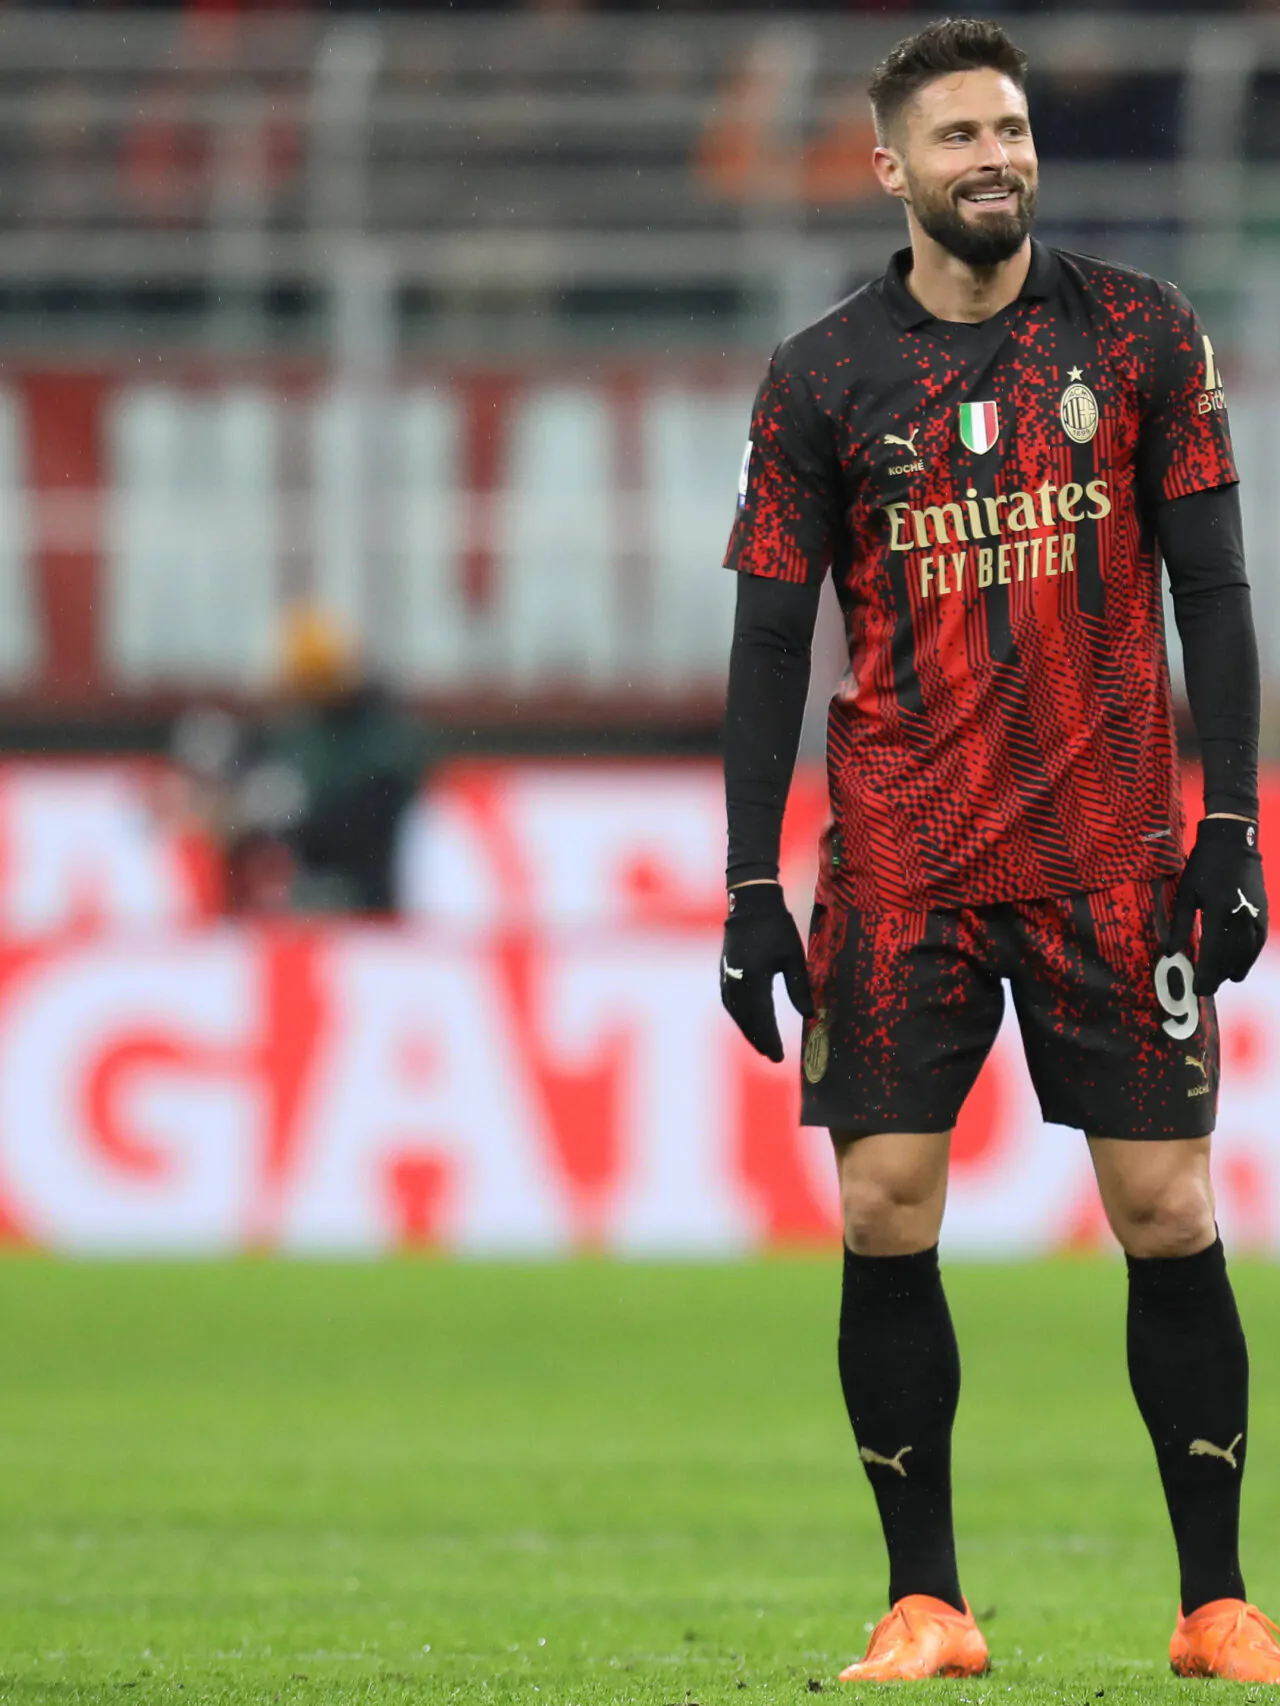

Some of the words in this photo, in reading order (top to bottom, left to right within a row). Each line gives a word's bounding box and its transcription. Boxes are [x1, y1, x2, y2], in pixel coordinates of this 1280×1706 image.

[888, 459, 925, 476] KOCHÉ
[882, 479, 1112, 551] Emirates
[920, 551, 968, 598] FLY
[978, 533, 1076, 588] BETTER
[1154, 952, 1199, 1040] 9
